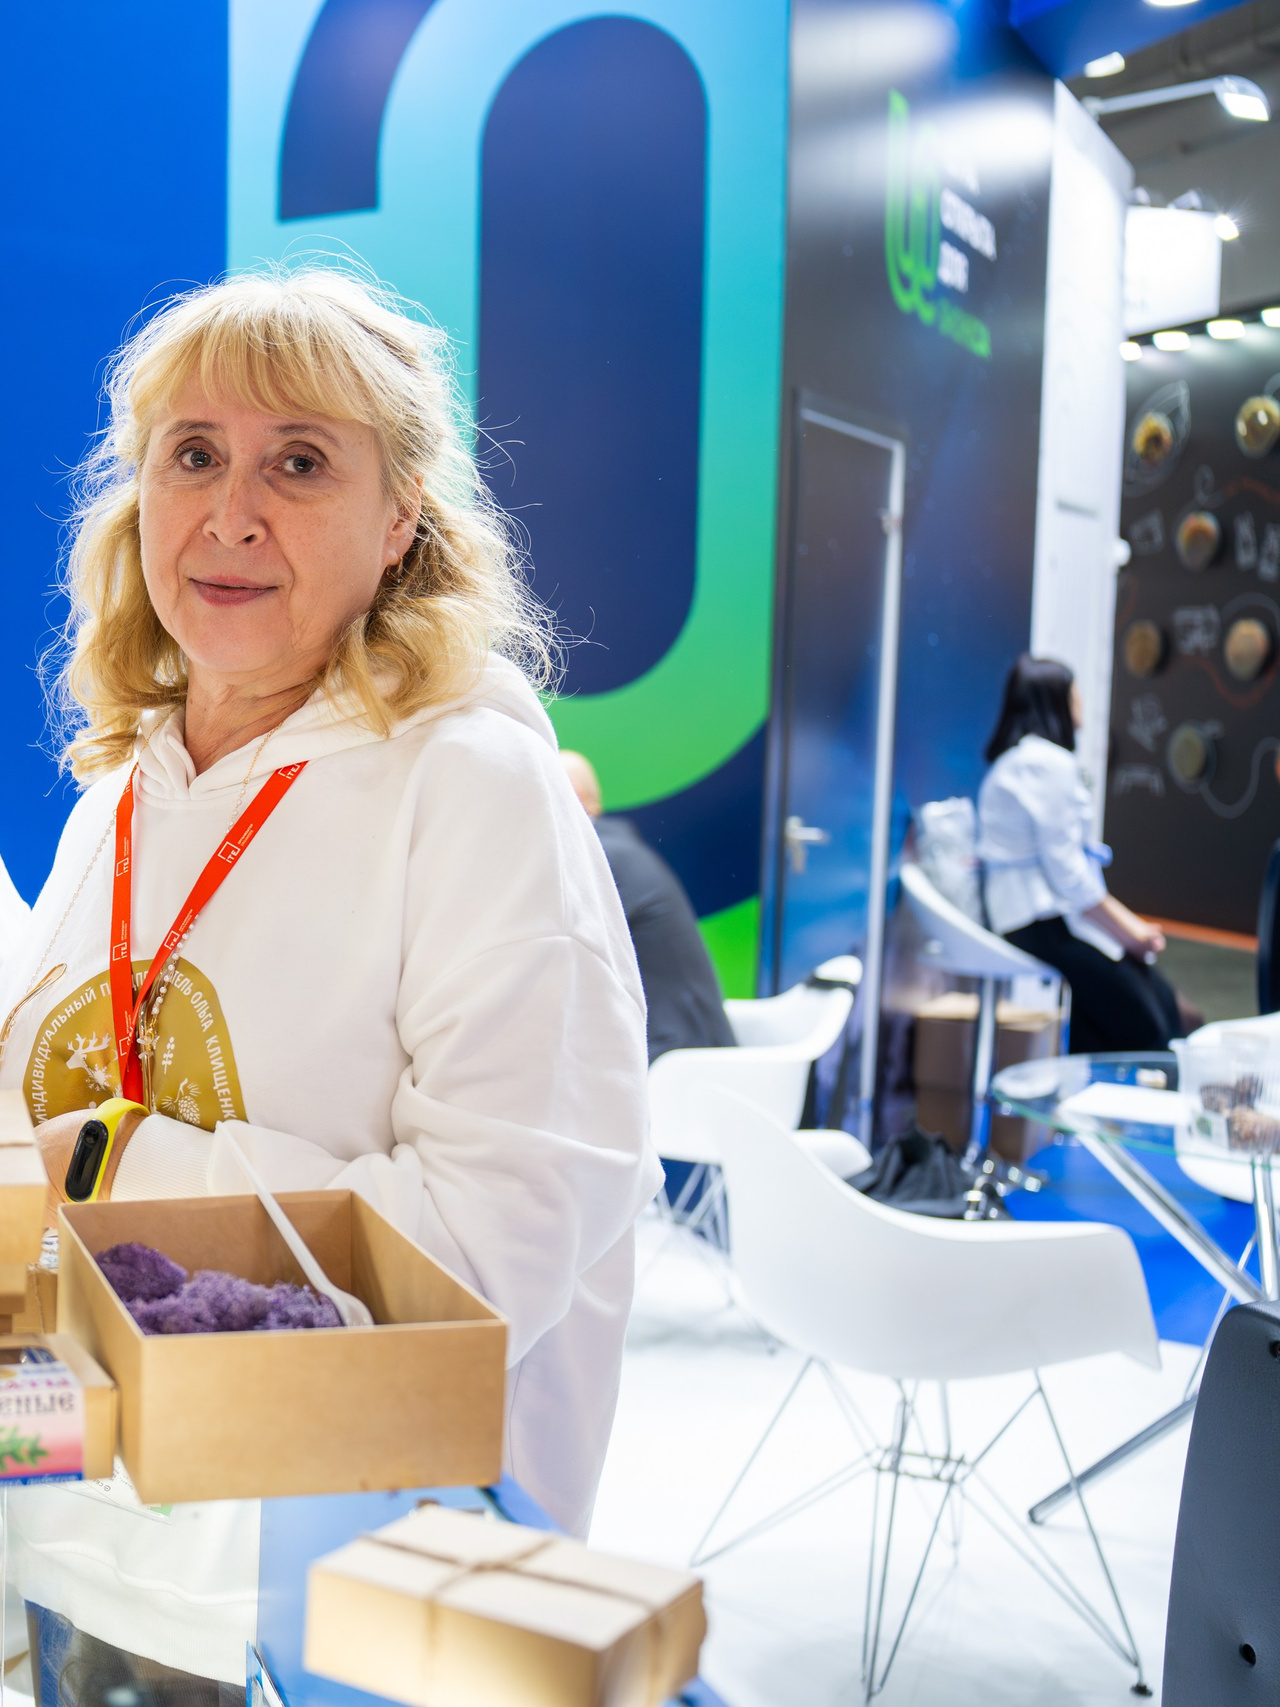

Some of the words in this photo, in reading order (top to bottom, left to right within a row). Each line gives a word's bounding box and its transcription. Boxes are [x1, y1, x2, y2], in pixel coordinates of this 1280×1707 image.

[31, 986, 97, 1124] ИНДИВИДУАЛЬНЫЙ
[190, 991, 215, 1032] ОЛЬГА
[205, 1035, 238, 1119] КЛИЩЕНК
